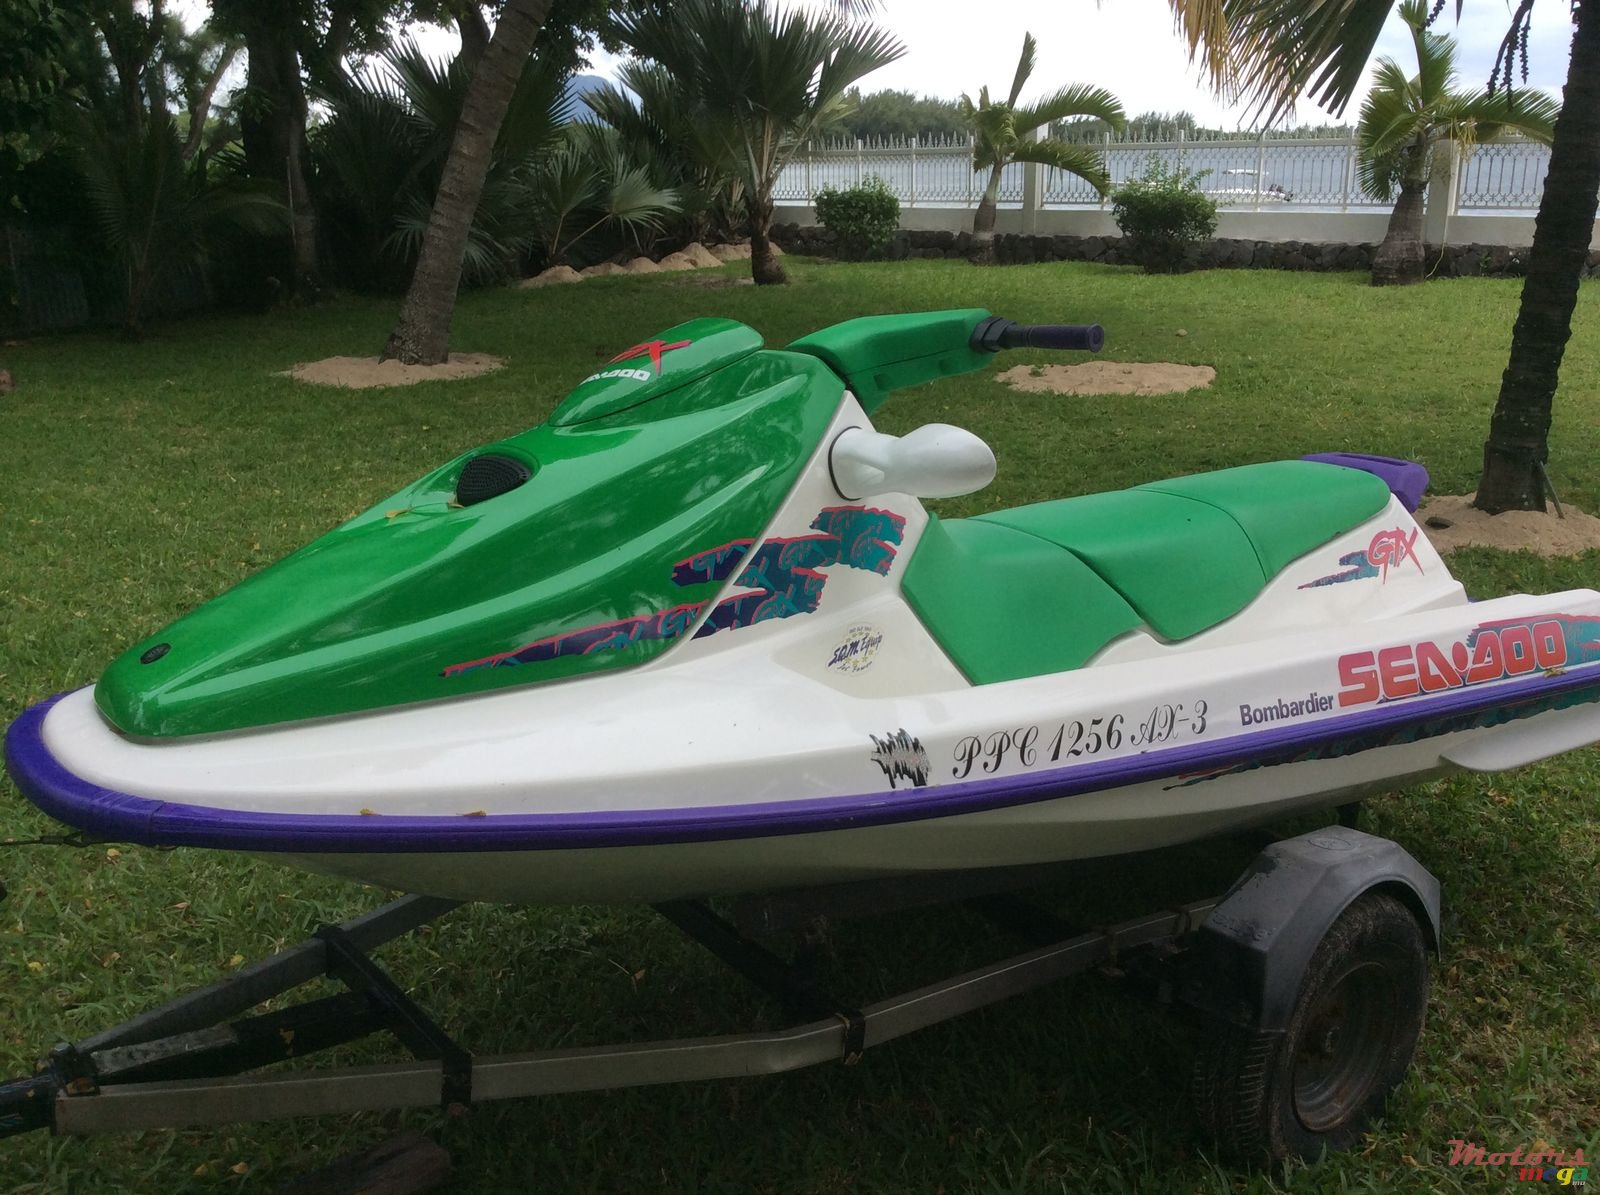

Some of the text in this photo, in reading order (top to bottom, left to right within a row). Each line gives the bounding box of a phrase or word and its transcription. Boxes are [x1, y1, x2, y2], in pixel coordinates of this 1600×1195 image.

[1367, 526, 1424, 585] GTX
[1240, 691, 1334, 726] Bombardier
[952, 725, 1039, 779] PPC
[1047, 714, 1125, 762] 1256
